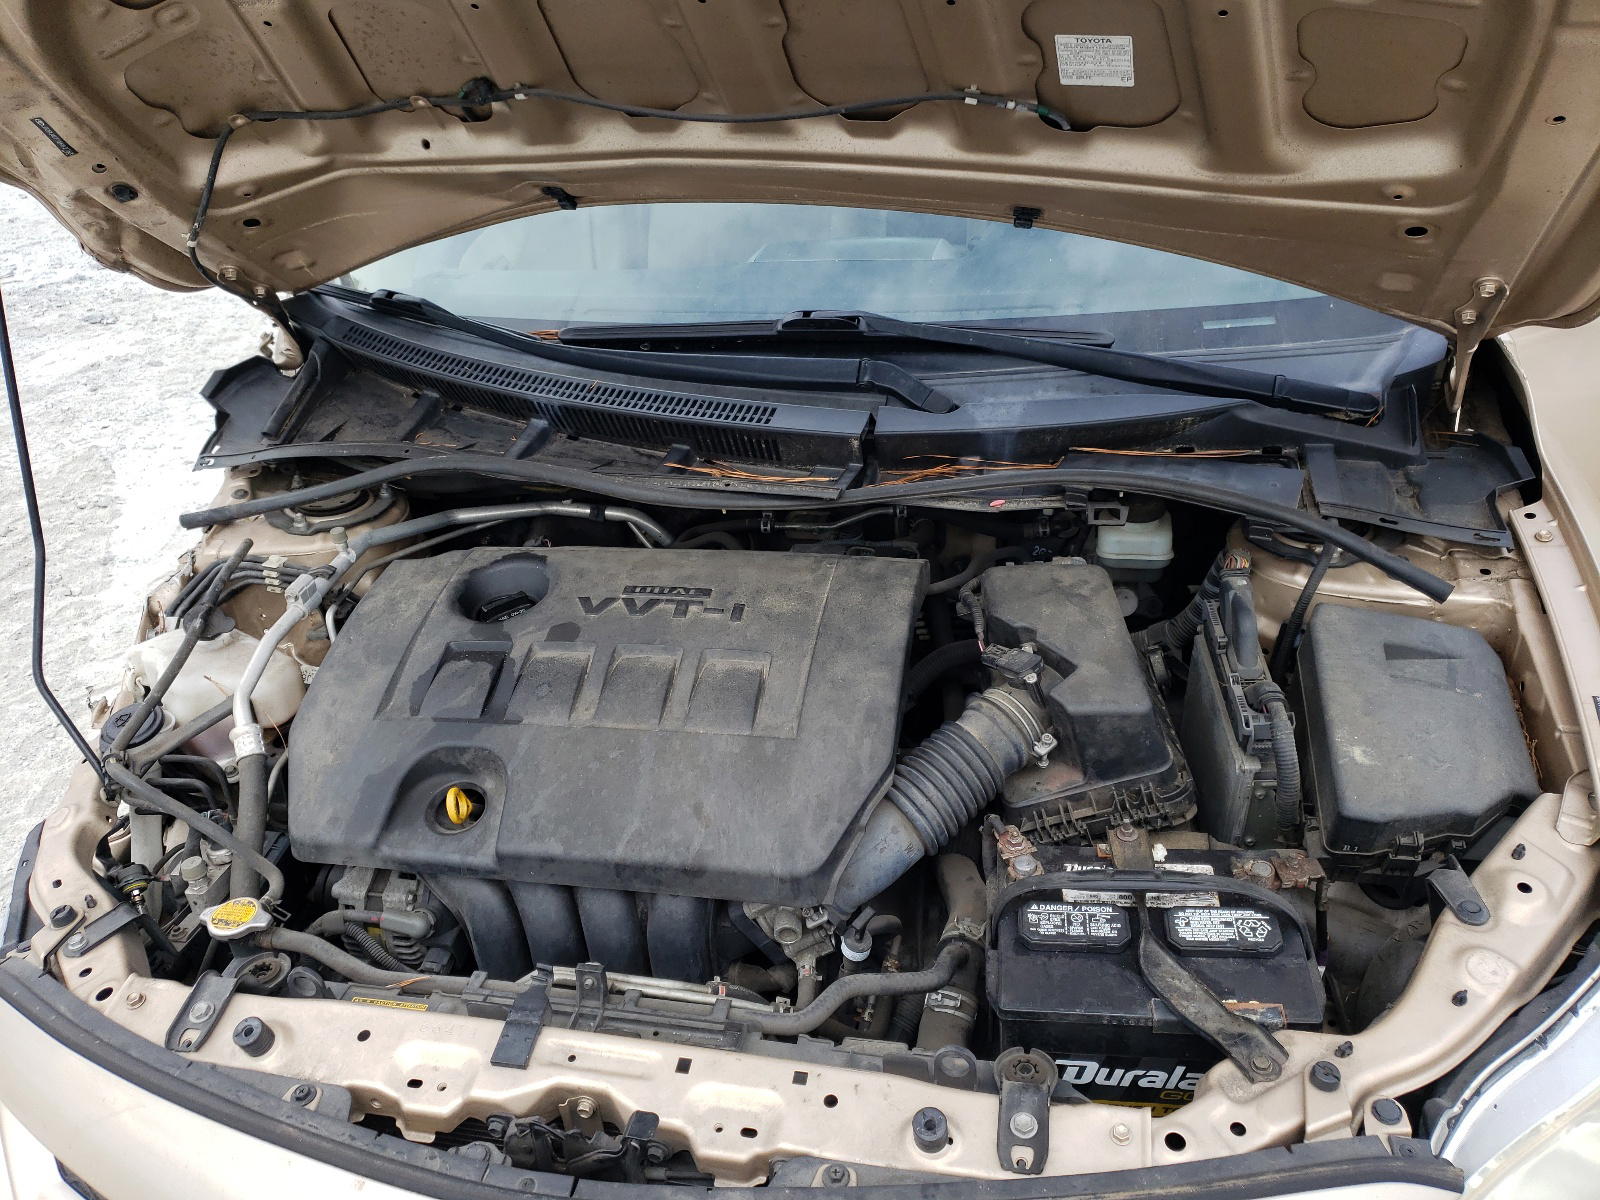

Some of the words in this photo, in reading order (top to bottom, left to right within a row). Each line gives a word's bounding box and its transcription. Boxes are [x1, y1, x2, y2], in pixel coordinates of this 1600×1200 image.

[1039, 904, 1073, 912] DANGER
[1081, 905, 1113, 913] POISON
[1055, 1059, 1206, 1090] Durala
